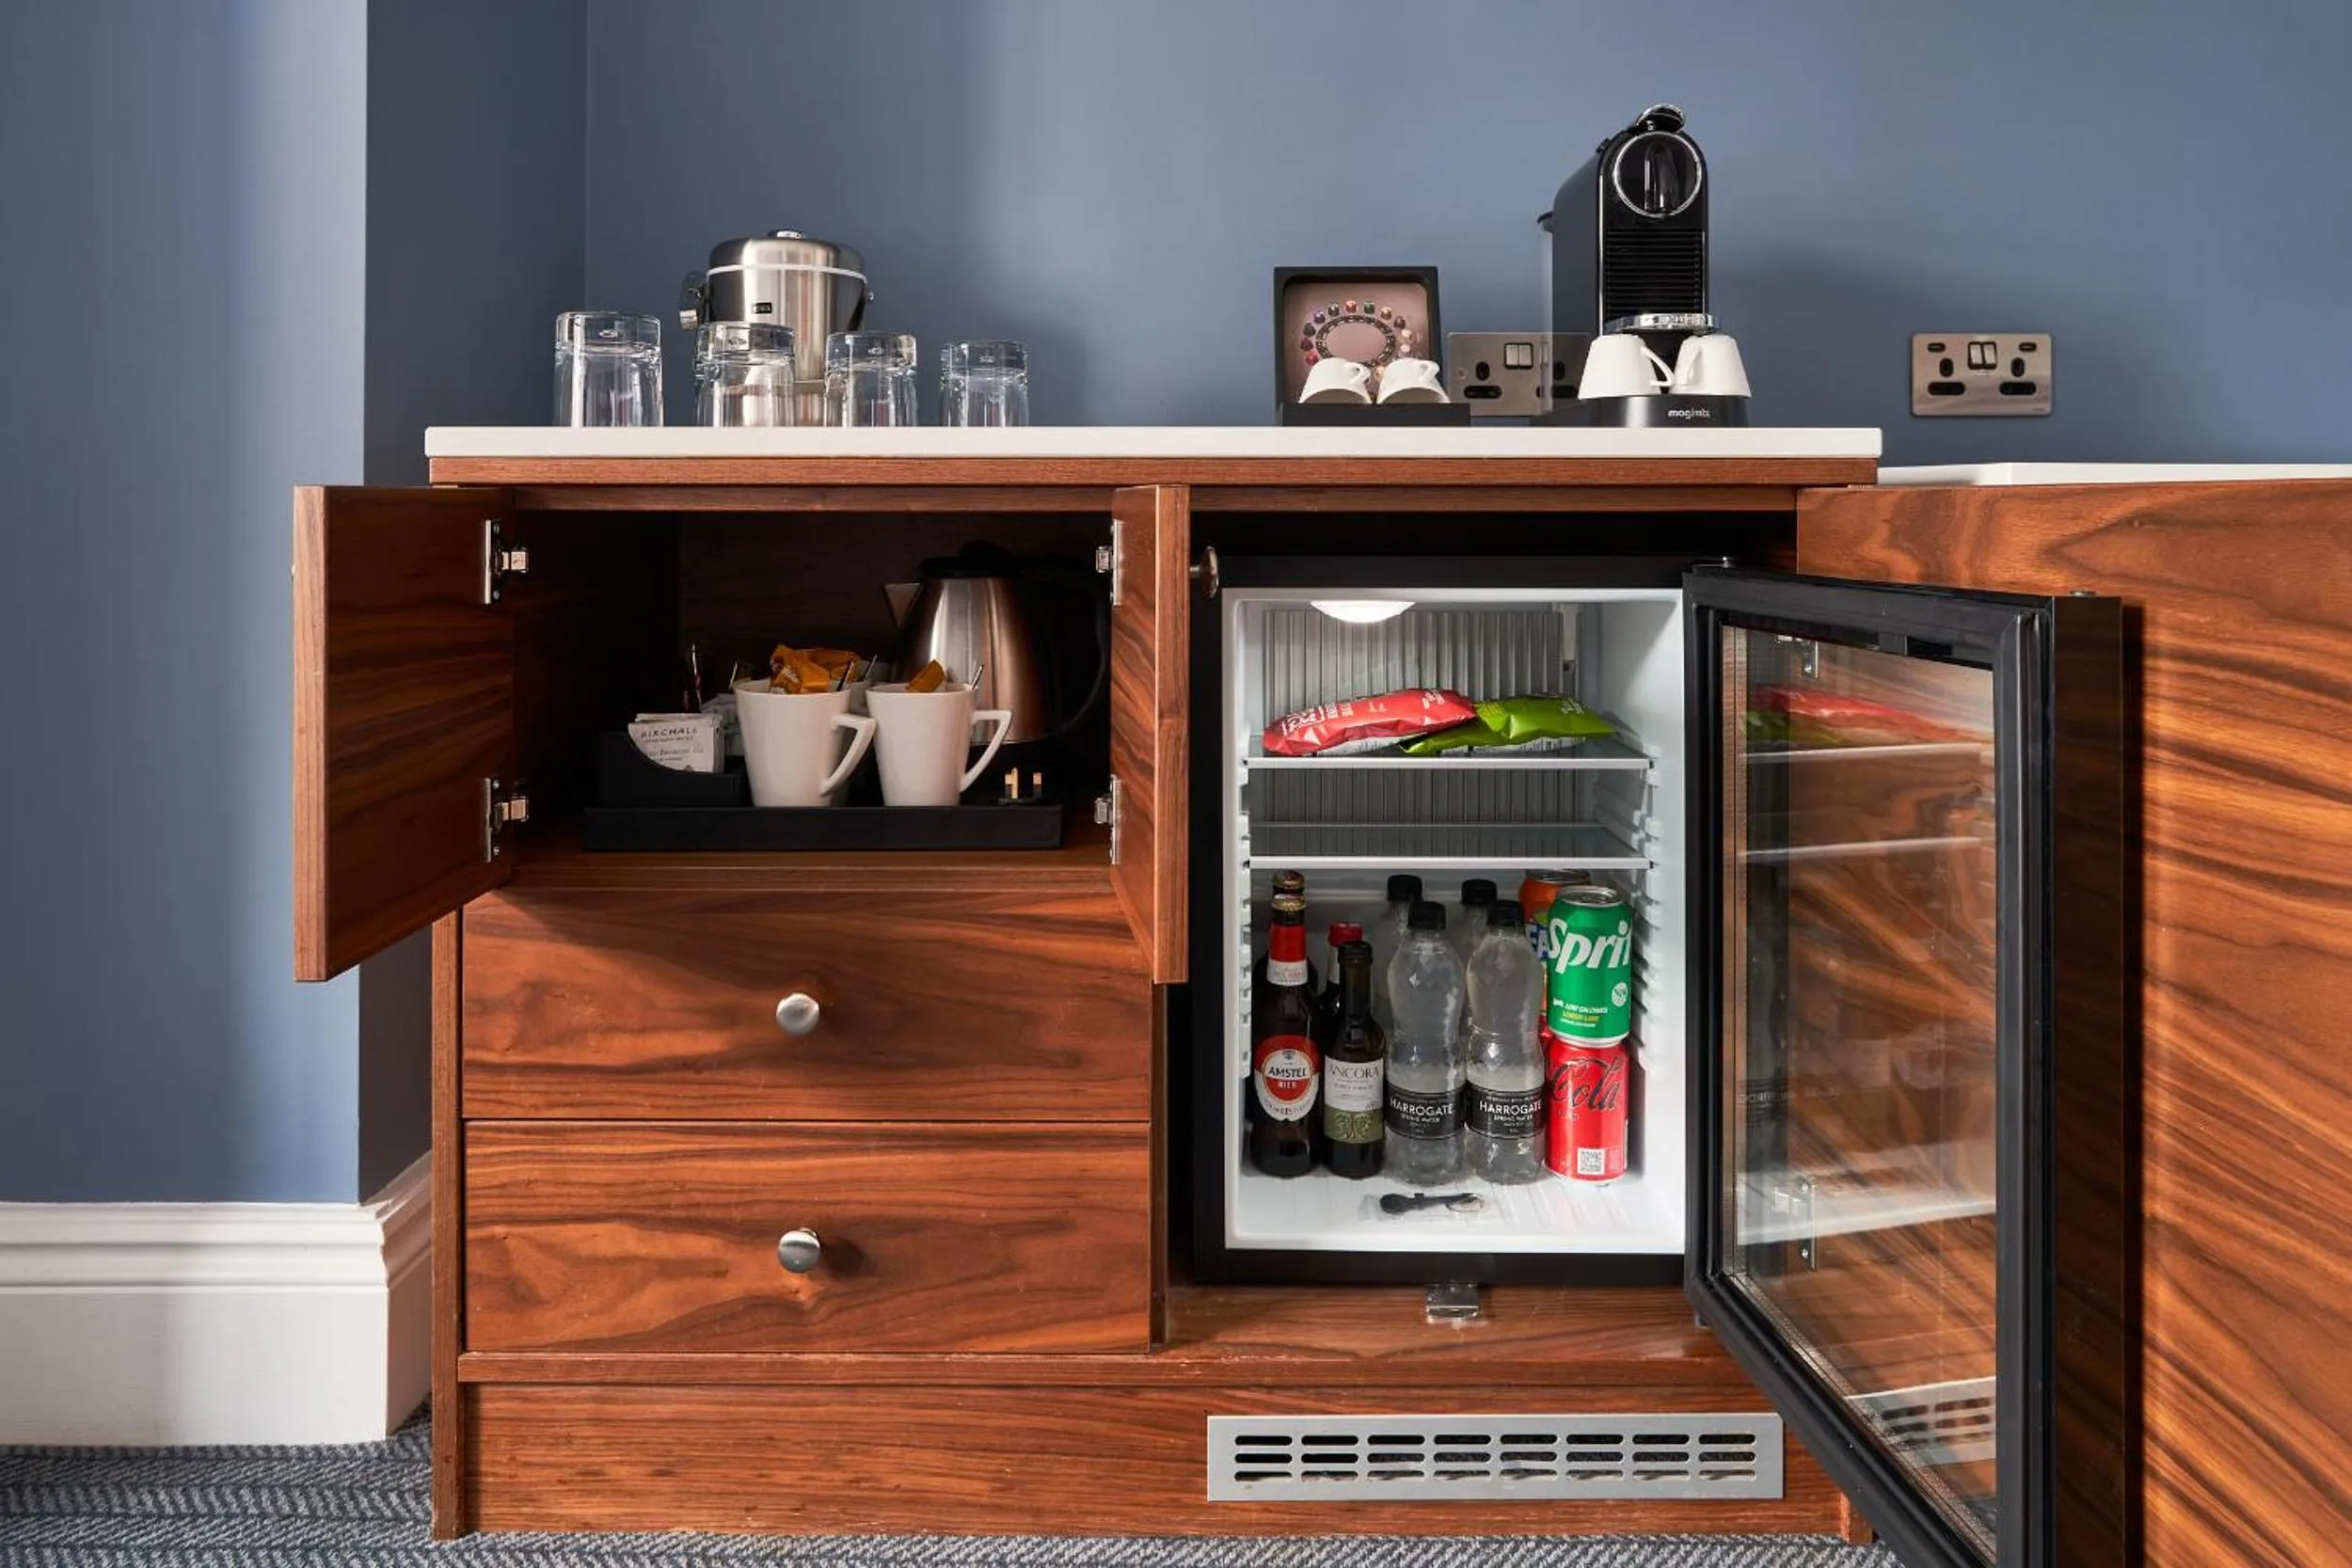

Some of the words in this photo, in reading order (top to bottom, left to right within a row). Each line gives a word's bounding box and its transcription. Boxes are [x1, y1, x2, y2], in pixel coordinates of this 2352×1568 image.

[1268, 1066, 1306, 1078] AMSTEL
[1328, 1064, 1379, 1080] ANCORA
[1552, 1055, 1620, 1110] Cola
[1390, 1097, 1454, 1117] HARROGATE
[1479, 1100, 1542, 1117] HARROGATE
